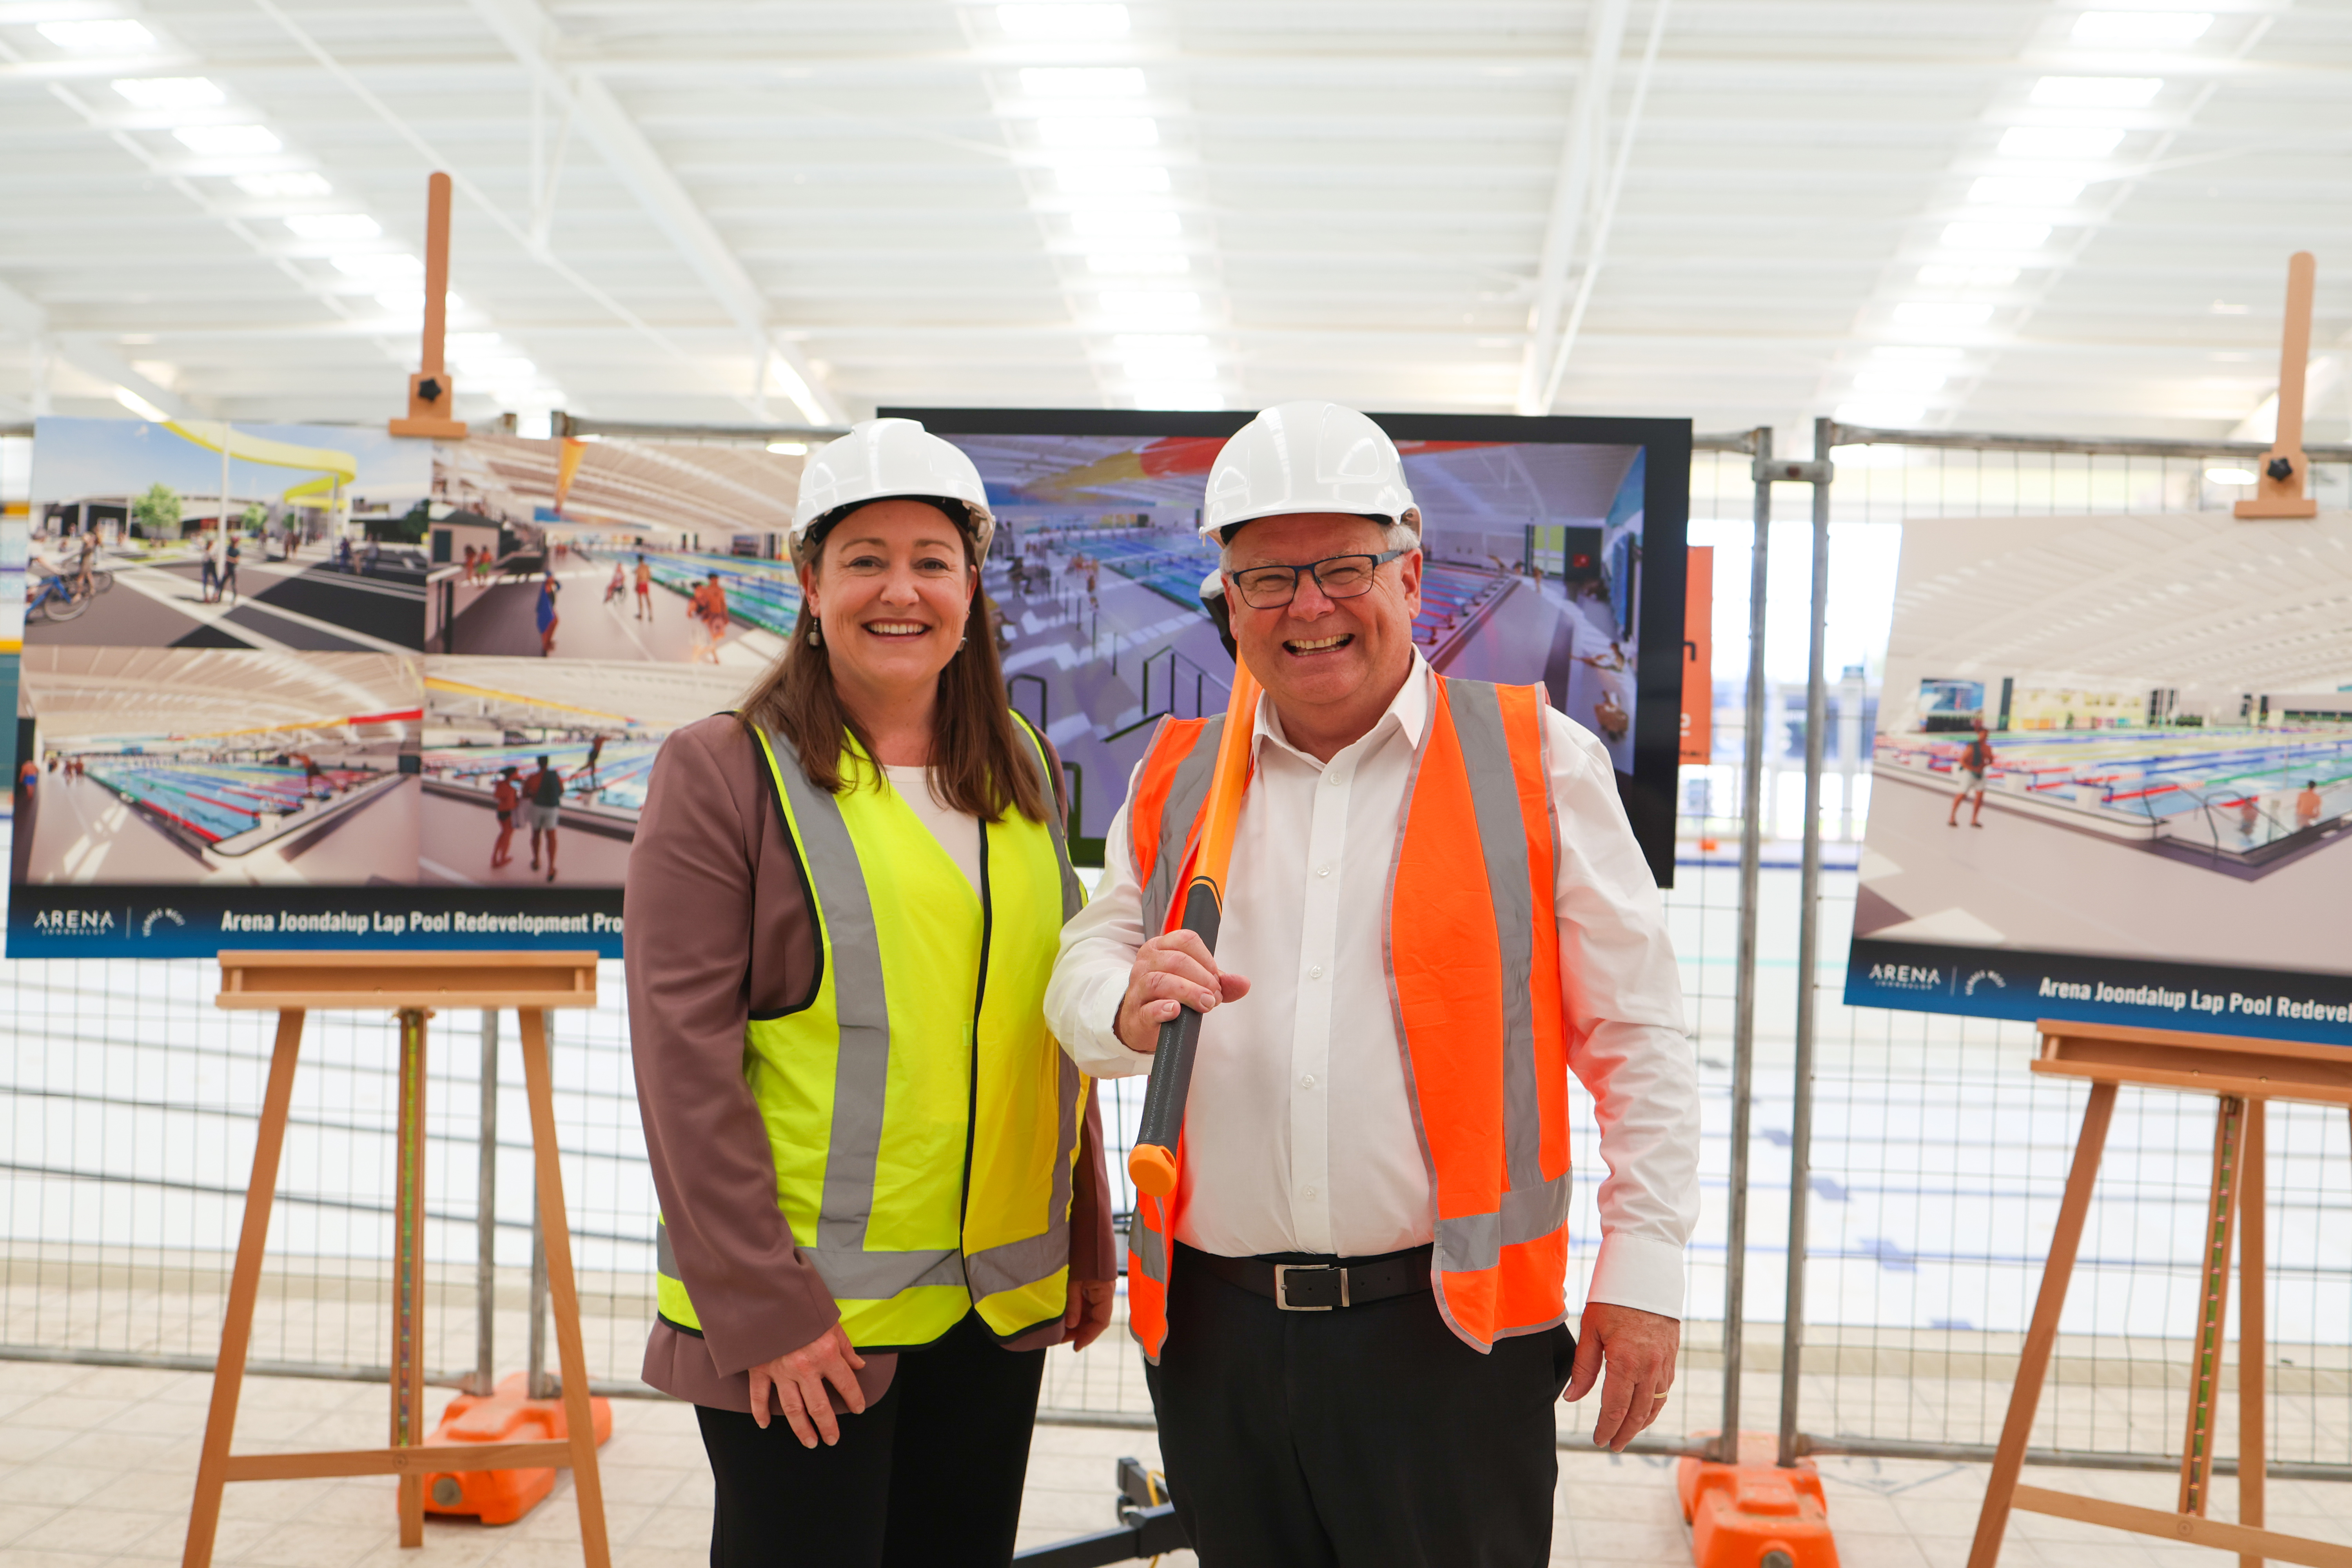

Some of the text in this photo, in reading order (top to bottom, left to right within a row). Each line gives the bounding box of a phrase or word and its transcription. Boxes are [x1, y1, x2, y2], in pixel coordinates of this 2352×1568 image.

[34, 909, 114, 929] ARENA
[220, 909, 624, 936] Arena Joondalup Lap Pool Redevelopment Pro
[1868, 964, 1941, 985] ARENA
[2038, 976, 2092, 1000] Arena
[2094, 981, 2187, 1012] Joondalup
[2190, 989, 2225, 1016] Lap
[2229, 992, 2272, 1016] Pool
